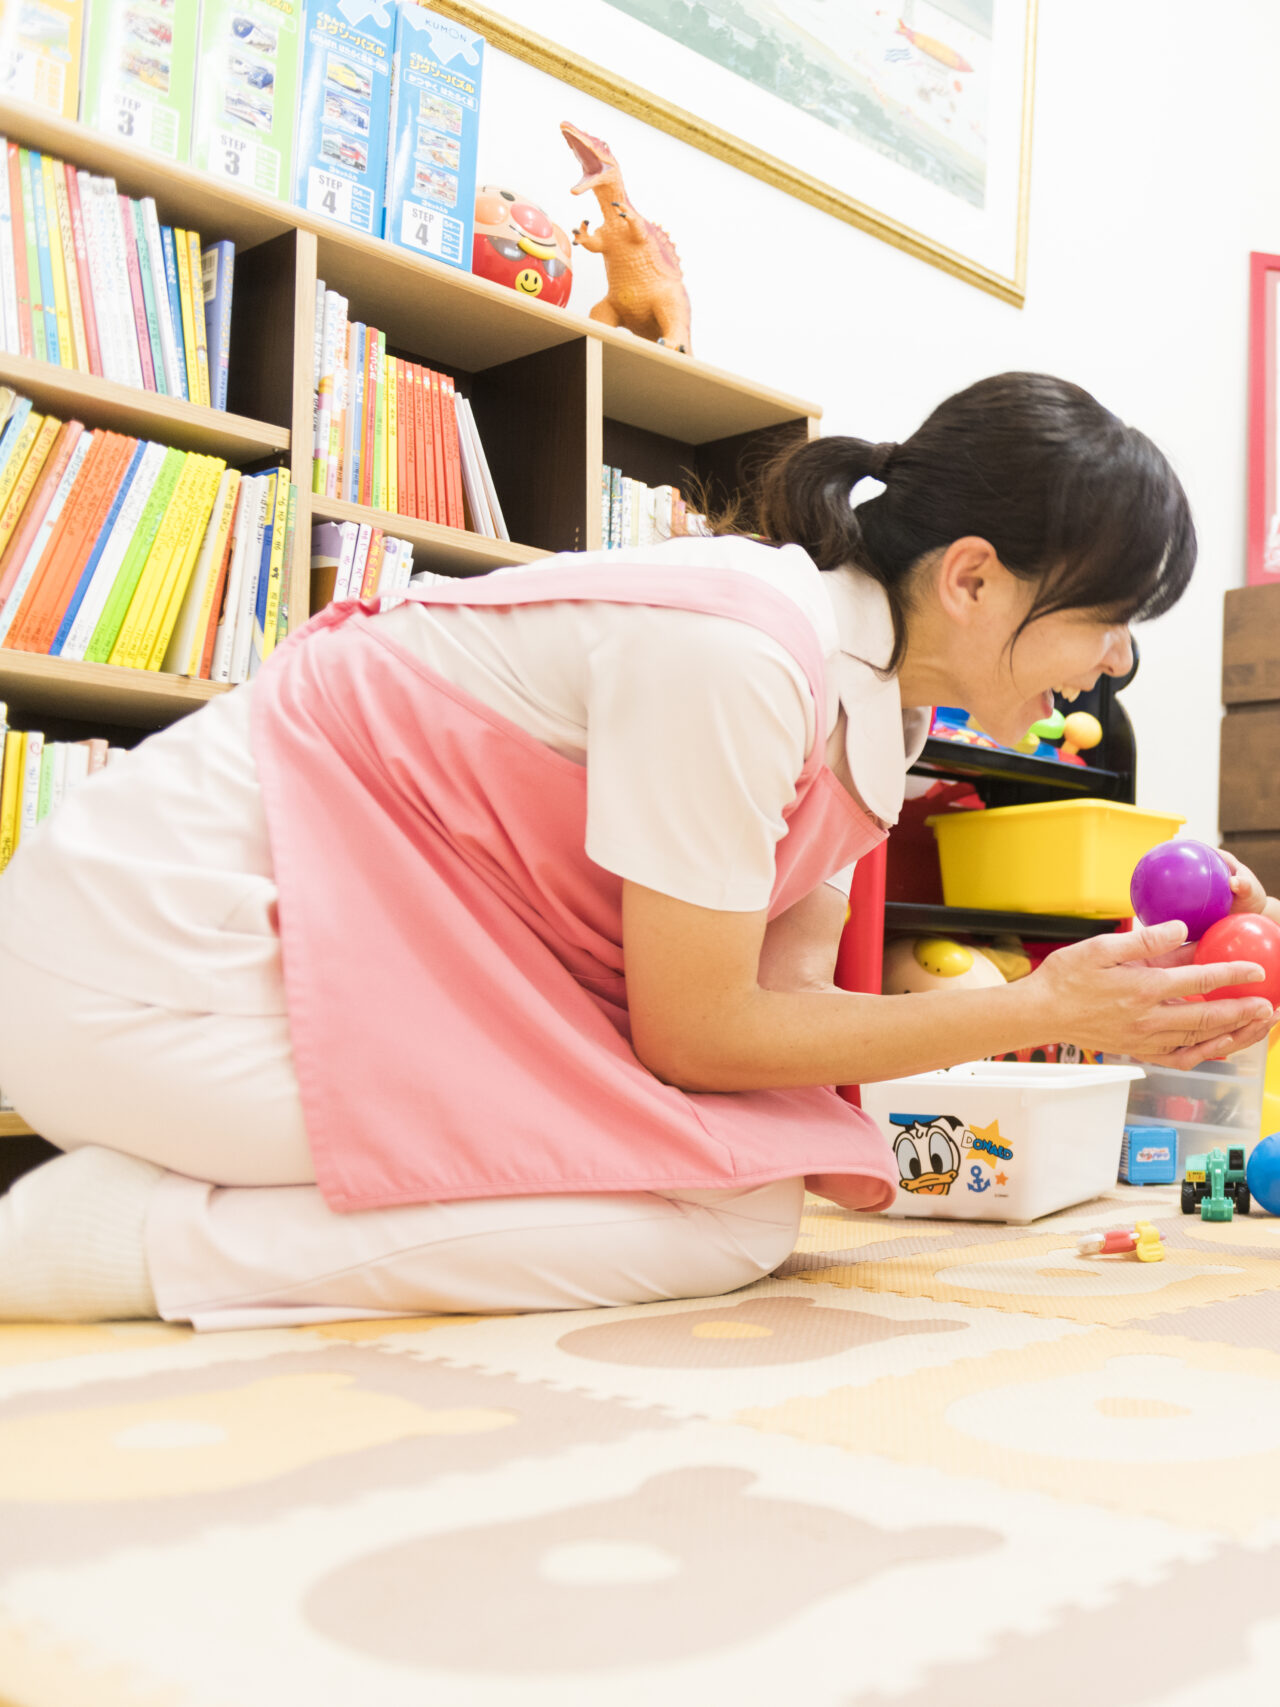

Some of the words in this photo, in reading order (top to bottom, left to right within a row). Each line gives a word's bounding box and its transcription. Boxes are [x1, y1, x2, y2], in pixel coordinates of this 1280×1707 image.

[317, 20, 385, 57] ジグソーパズル
[425, 19, 467, 42] KUMON
[409, 60, 475, 94] ジグソーパズル
[113, 92, 142, 111] STEP
[117, 109, 134, 137] 3
[221, 134, 247, 152] STEP
[224, 150, 240, 176] 3
[318, 174, 343, 190] STEP
[322, 190, 336, 214] 4
[412, 208, 434, 222] STEP
[415, 223, 429, 246] 4
[961, 1129, 1013, 1160] DONALD
